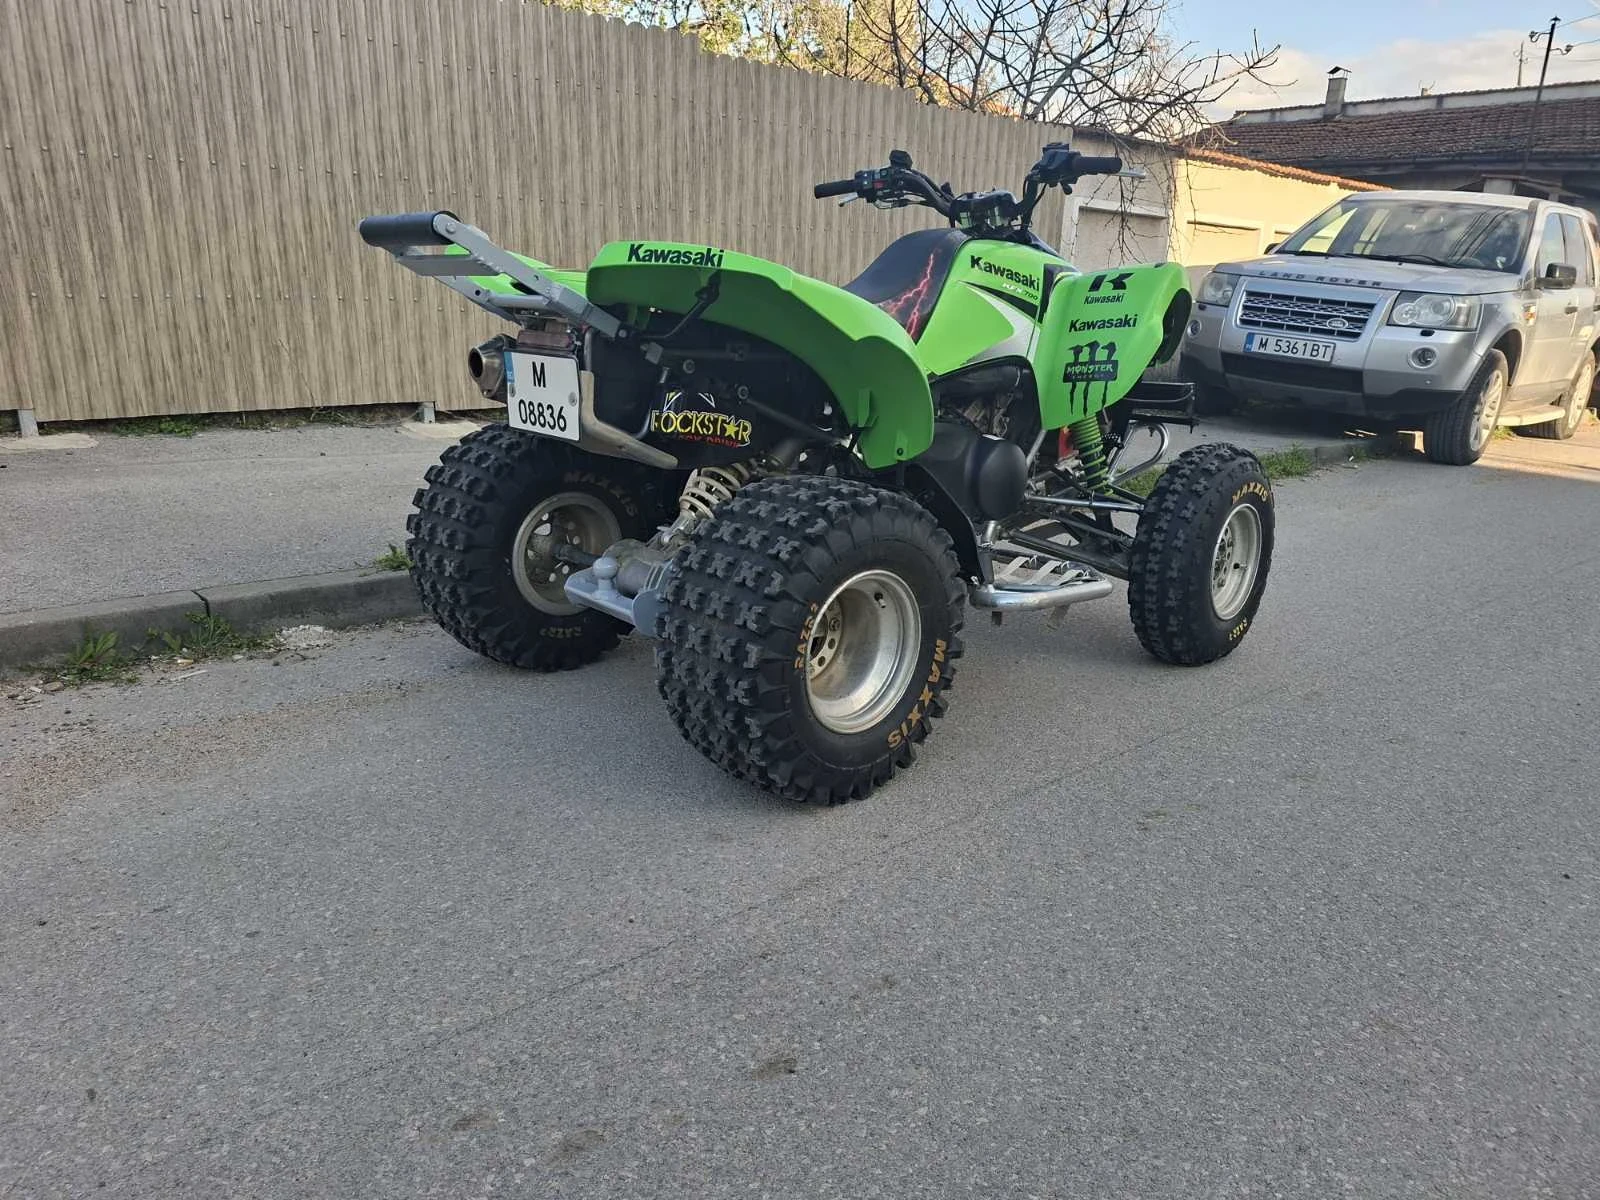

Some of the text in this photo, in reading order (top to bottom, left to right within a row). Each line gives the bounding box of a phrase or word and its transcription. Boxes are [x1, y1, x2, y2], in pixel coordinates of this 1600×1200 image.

[627, 243, 724, 267] Kawasaki
[970, 255, 1040, 291] Kawasaki
[1259, 270, 1383, 287] LAND ROVER
[1083, 293, 1126, 304] Kawasaki
[1069, 313, 1138, 332] Kawasaki
[1258, 337, 1268, 351] M
[532, 361, 546, 388] M
[1066, 363, 1113, 375] MONSTER
[518, 398, 567, 432] 08836
[1232, 481, 1268, 504] MAXXIS
[887, 639, 947, 749] MAXXIS
